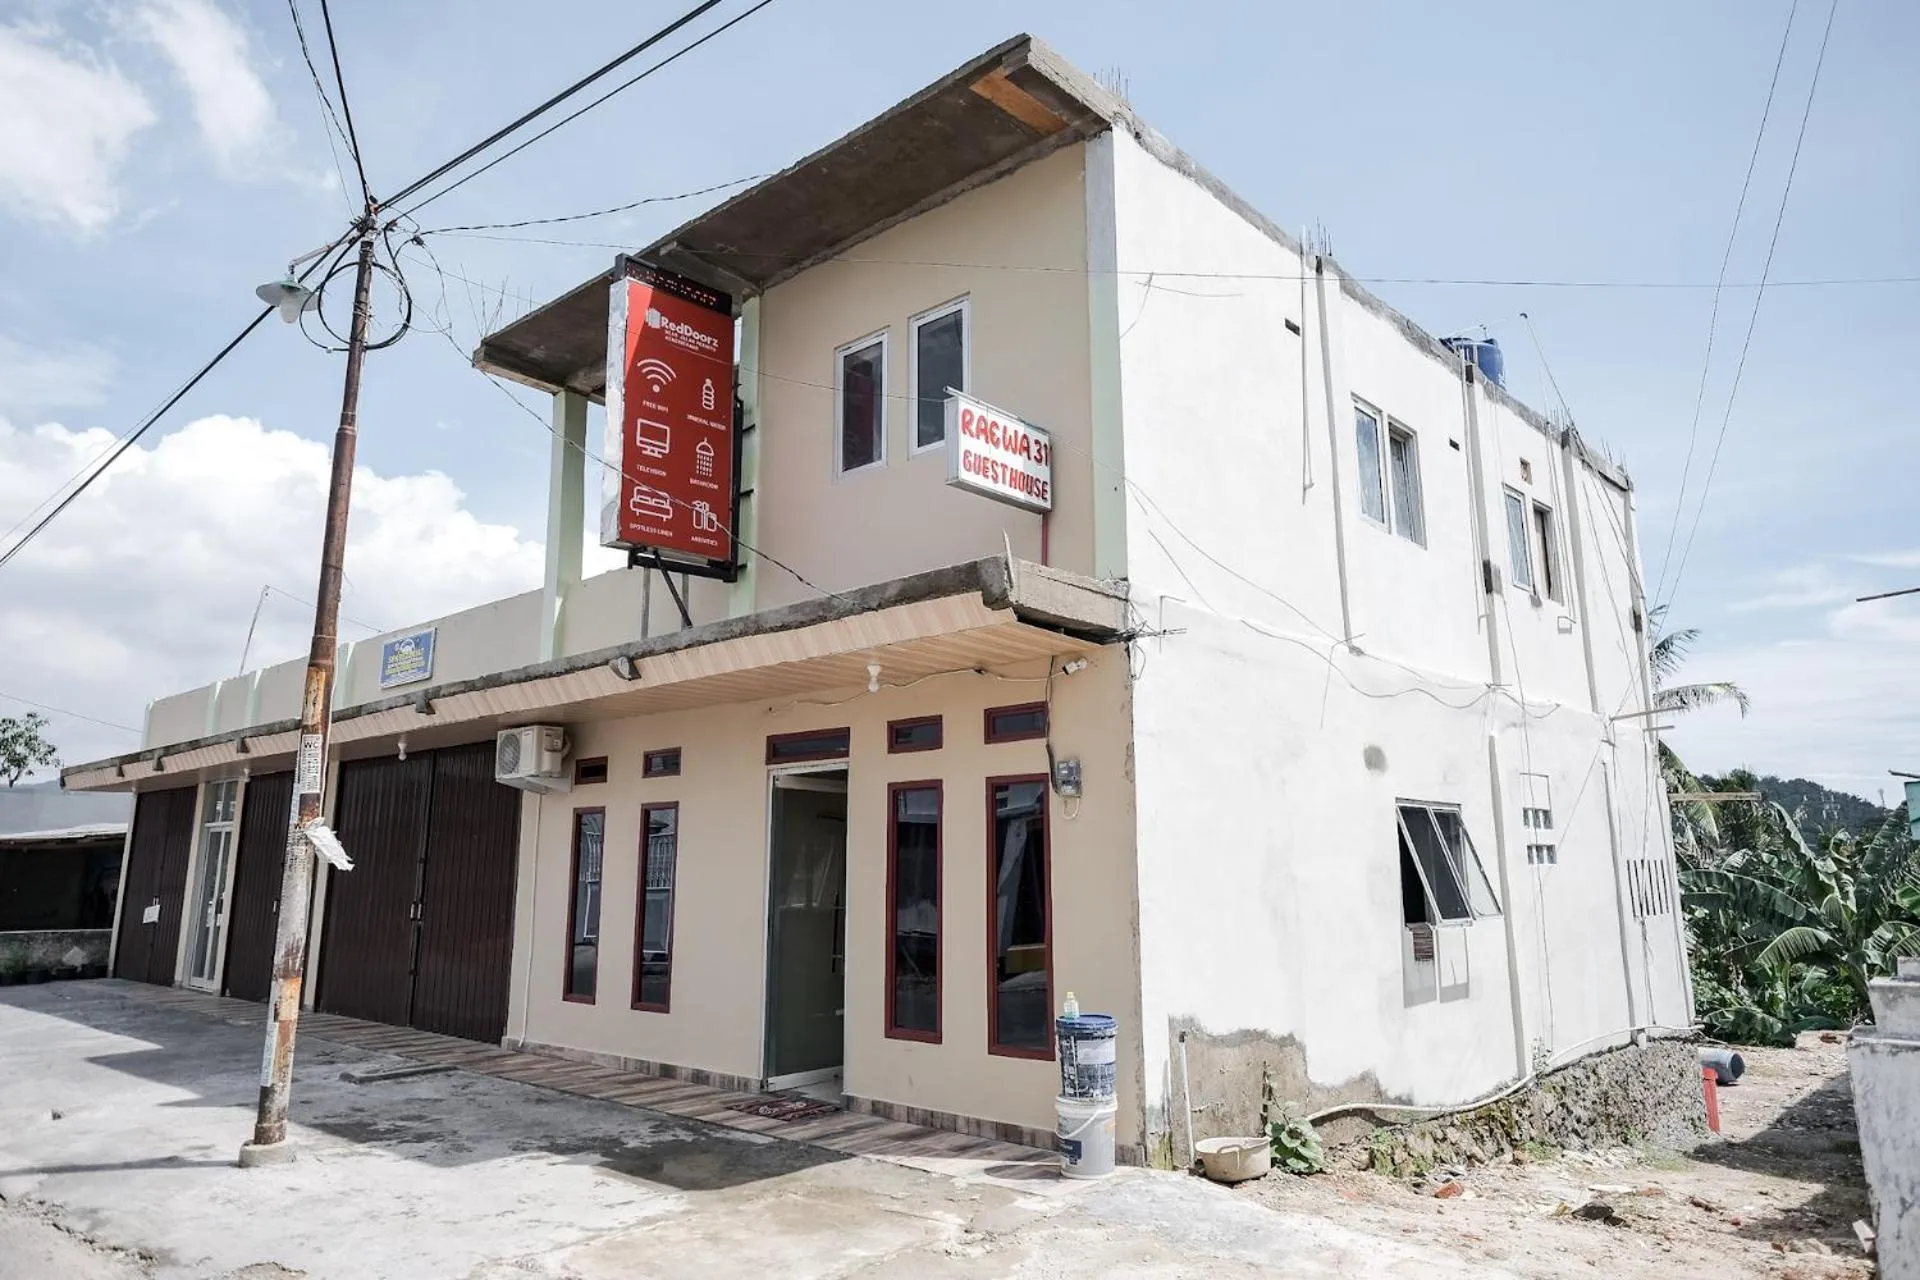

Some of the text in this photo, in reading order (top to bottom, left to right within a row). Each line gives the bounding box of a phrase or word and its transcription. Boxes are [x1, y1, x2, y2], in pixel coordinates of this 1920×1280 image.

[661, 316, 719, 347] RedDoorz
[636, 464, 667, 477] TELEVISION
[963, 449, 1049, 502] GUESTHOUSE
